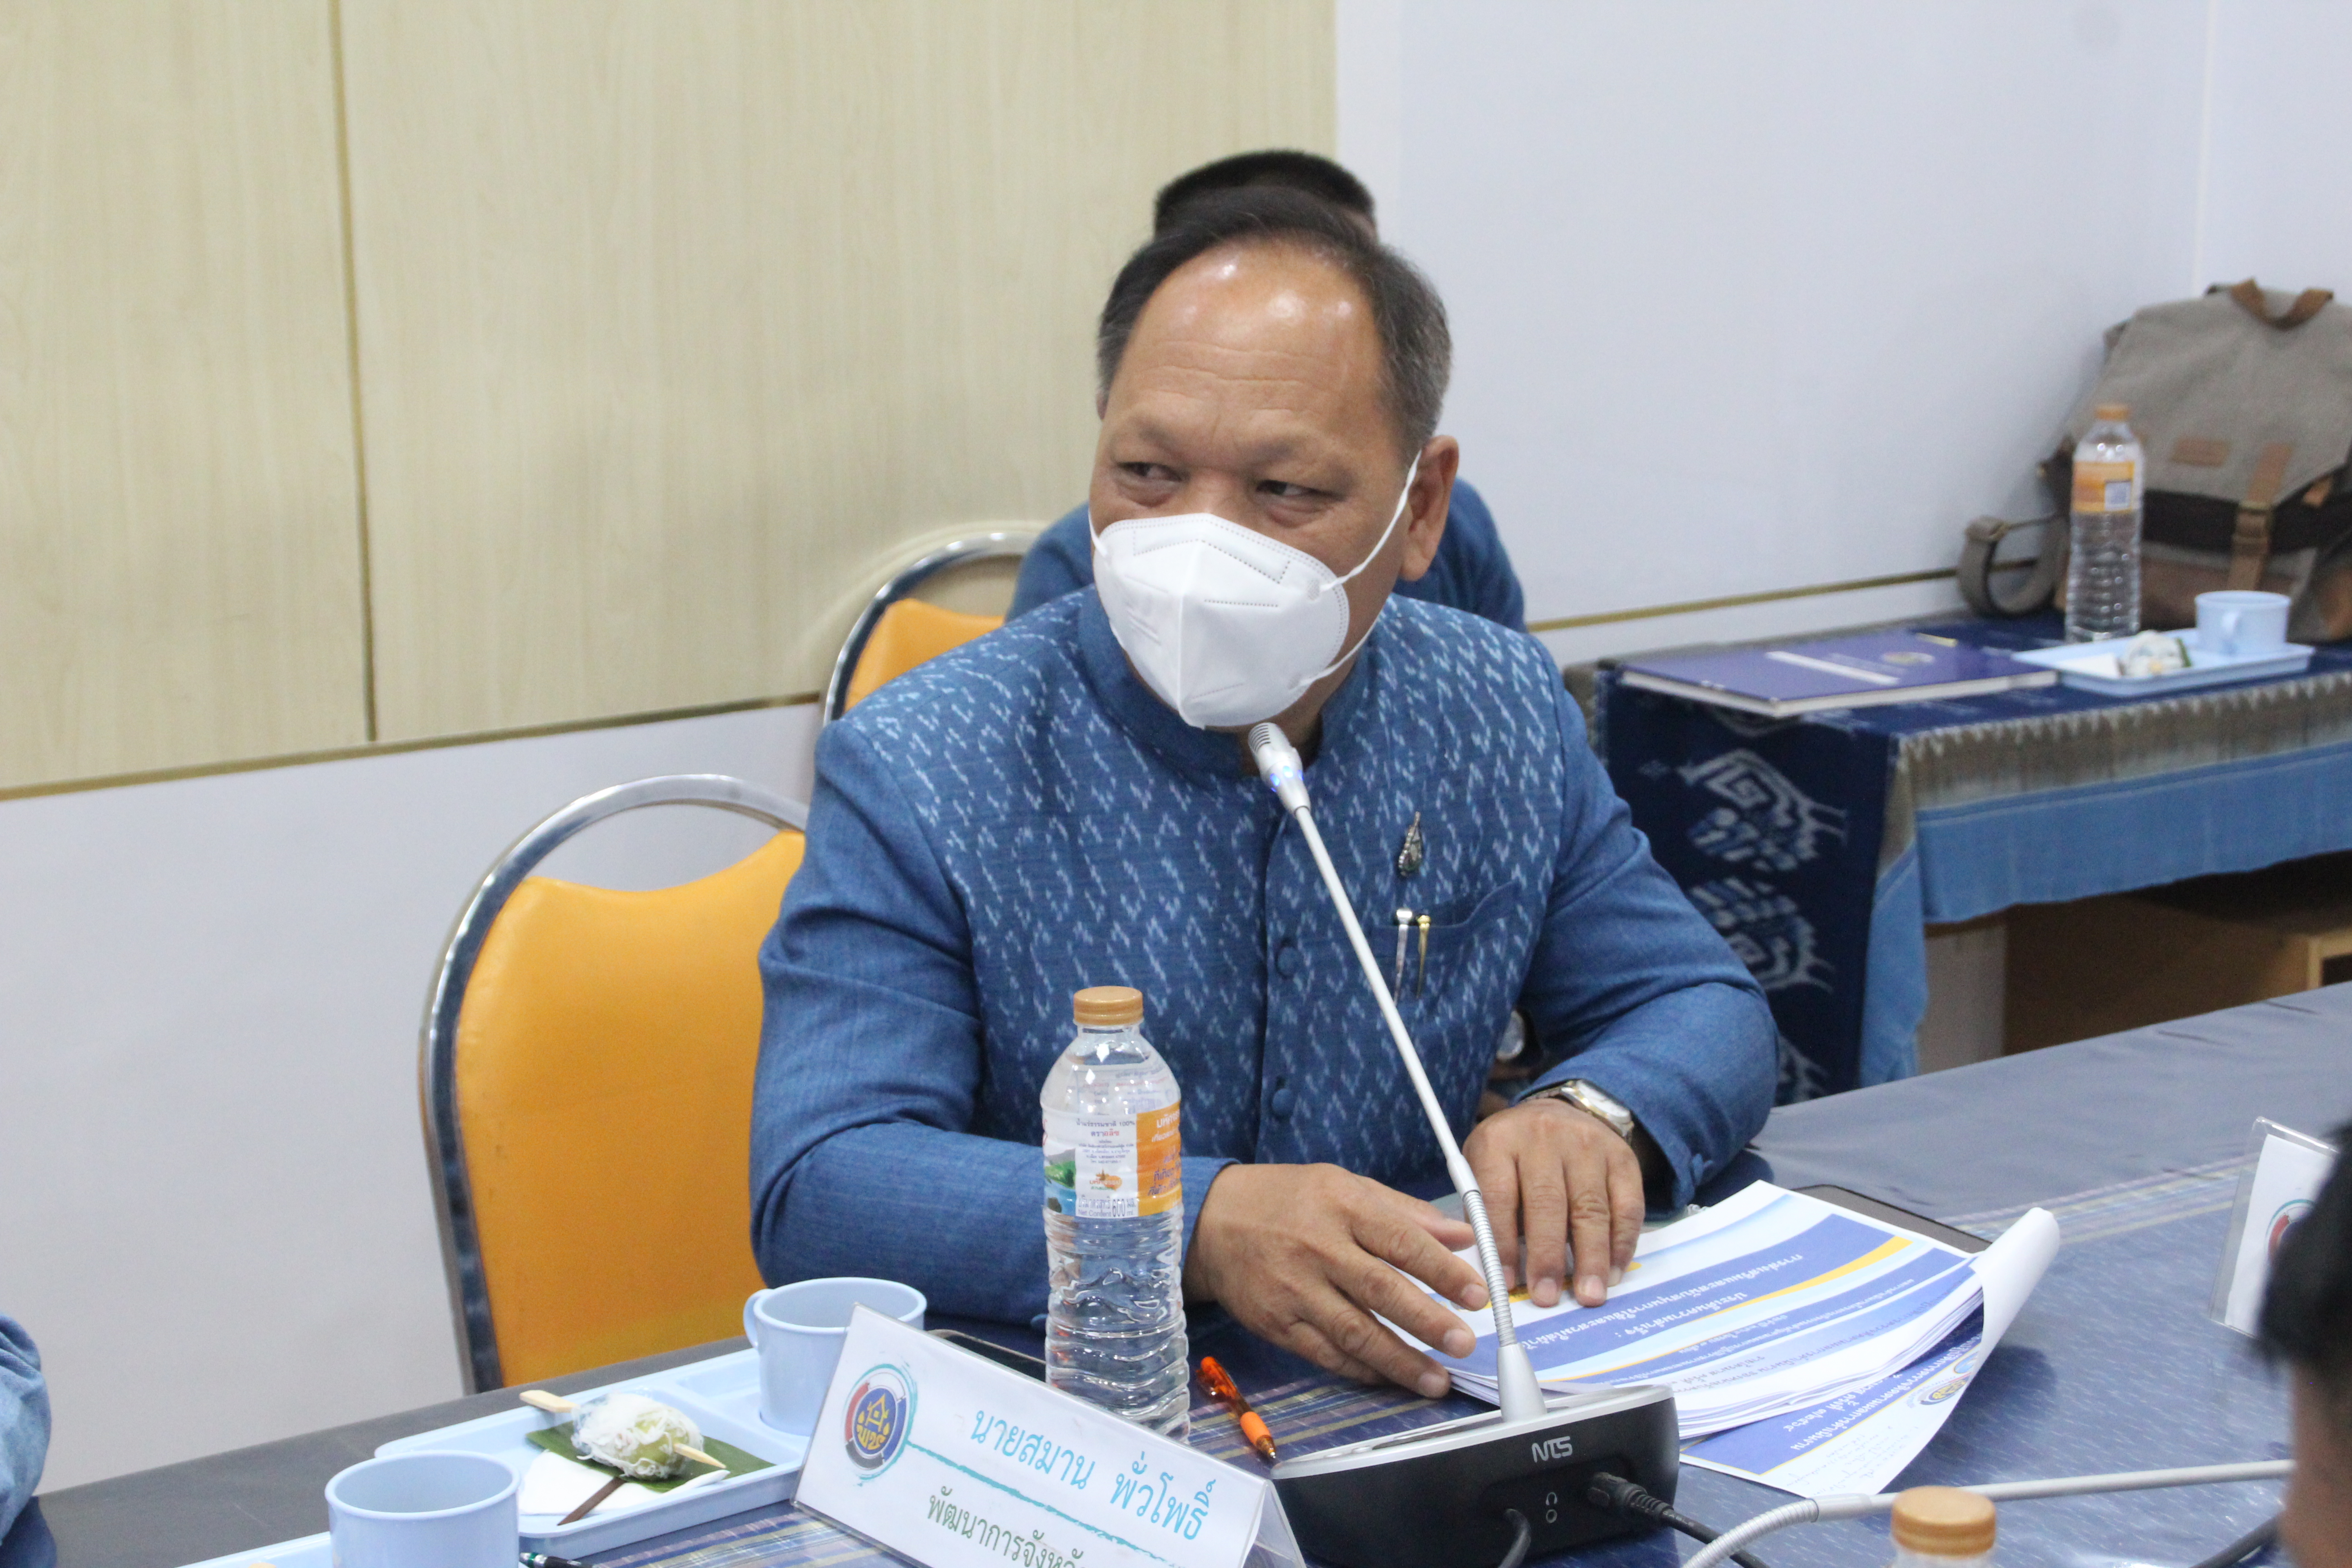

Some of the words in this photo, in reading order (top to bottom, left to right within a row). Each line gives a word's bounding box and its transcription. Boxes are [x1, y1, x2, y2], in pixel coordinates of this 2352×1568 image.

[1089, 1209, 1111, 1217] Content
[1112, 1198, 1125, 1217] 600
[1826, 1393, 1860, 1412] ครั้งที่
[970, 1410, 1096, 1490] นายสมาน
[1110, 1450, 1216, 1540] พั่วโพธิ์
